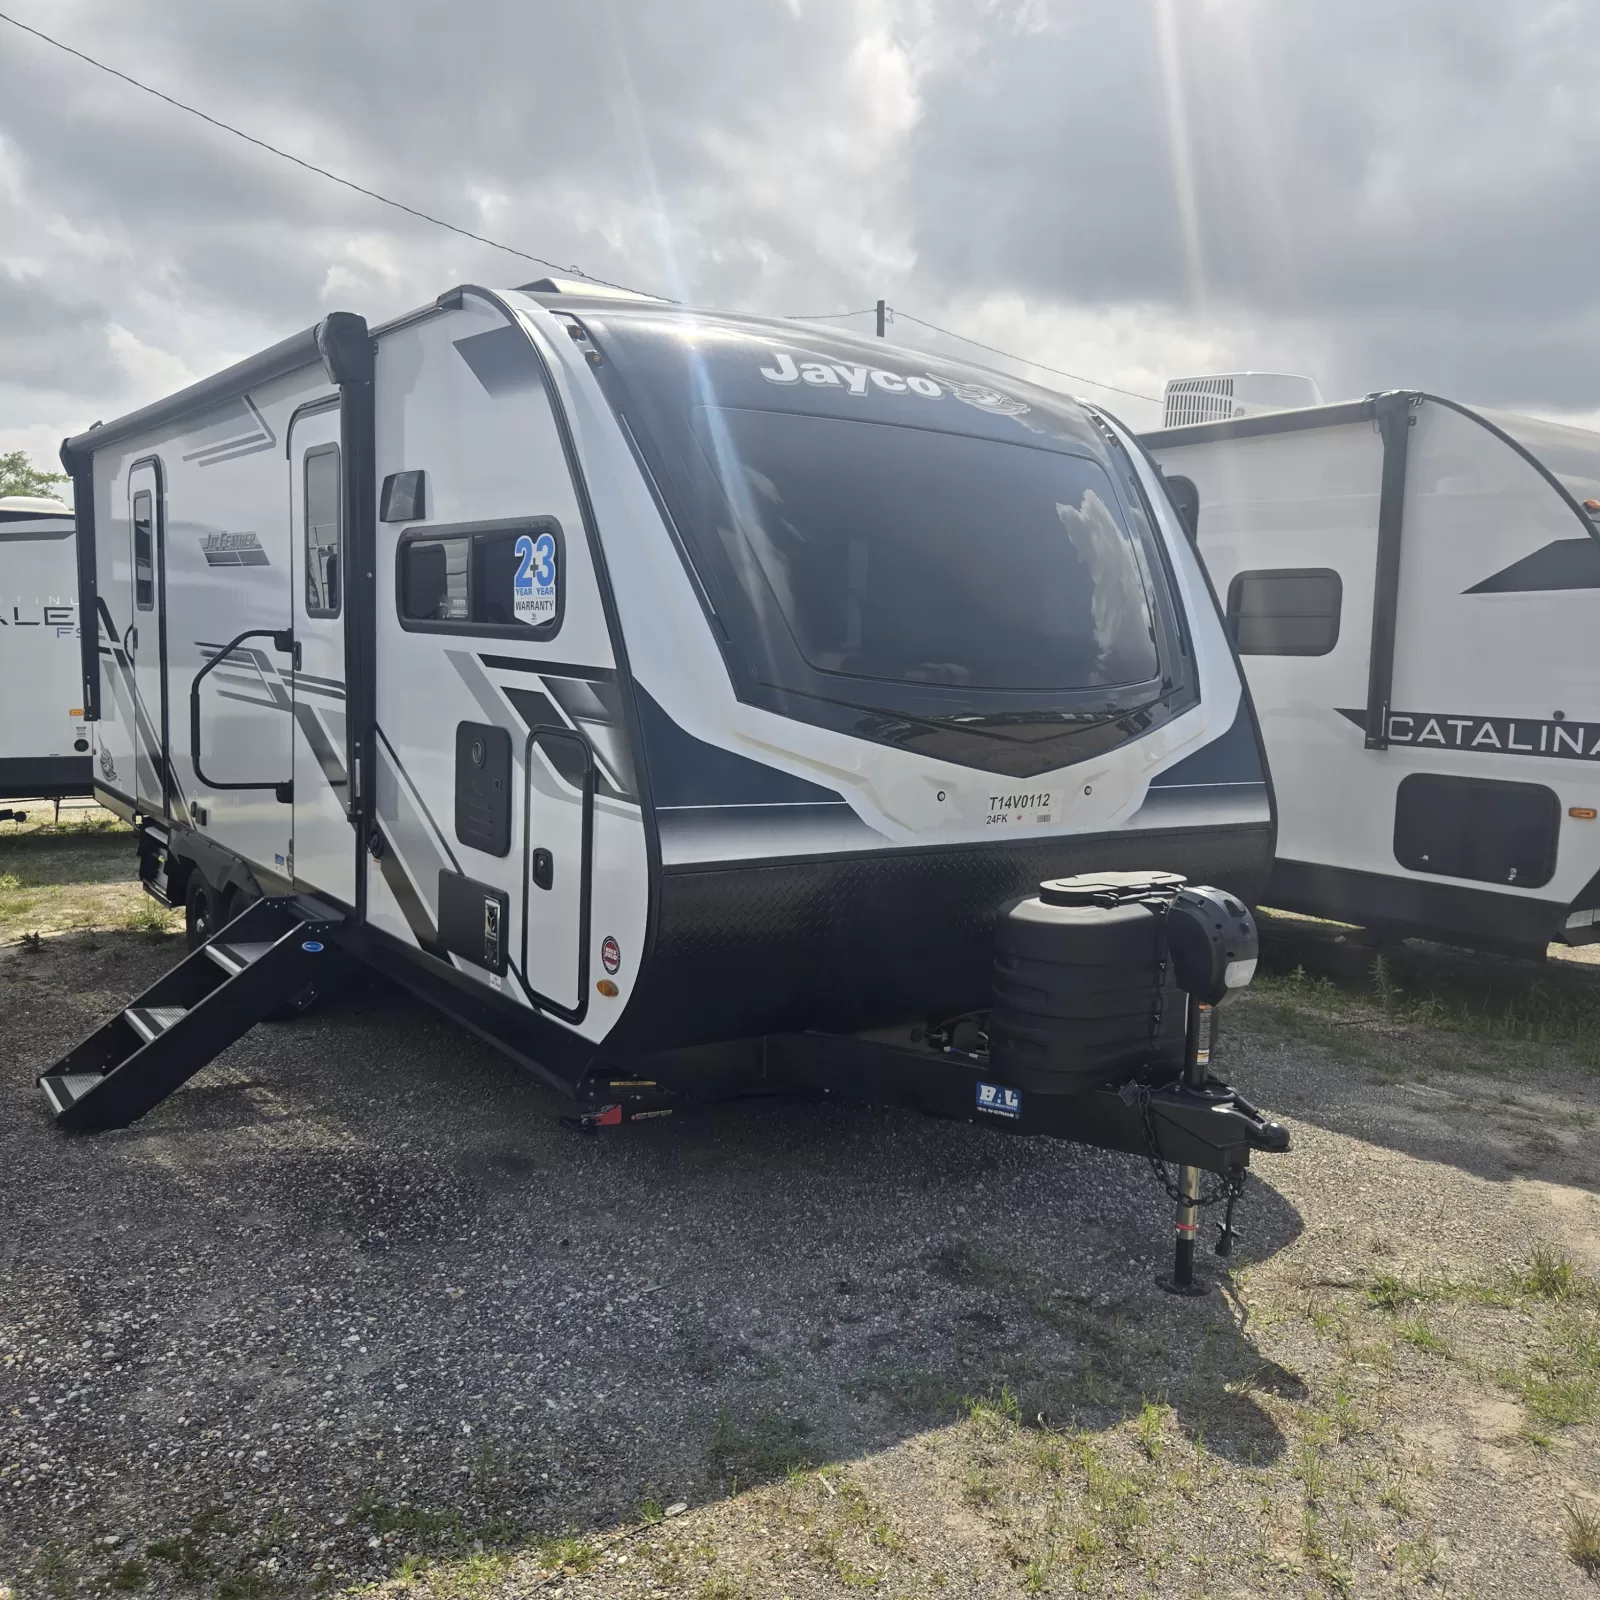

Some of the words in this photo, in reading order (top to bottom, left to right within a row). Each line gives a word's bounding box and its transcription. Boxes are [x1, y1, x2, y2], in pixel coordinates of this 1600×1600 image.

[759, 353, 944, 398] Jayco
[515, 587, 533, 596] YEAR
[536, 587, 554, 596] YEAR
[515, 601, 554, 611] WARRANTY
[989, 793, 1051, 811] T14V0112
[986, 813, 1009, 825] 24FK
